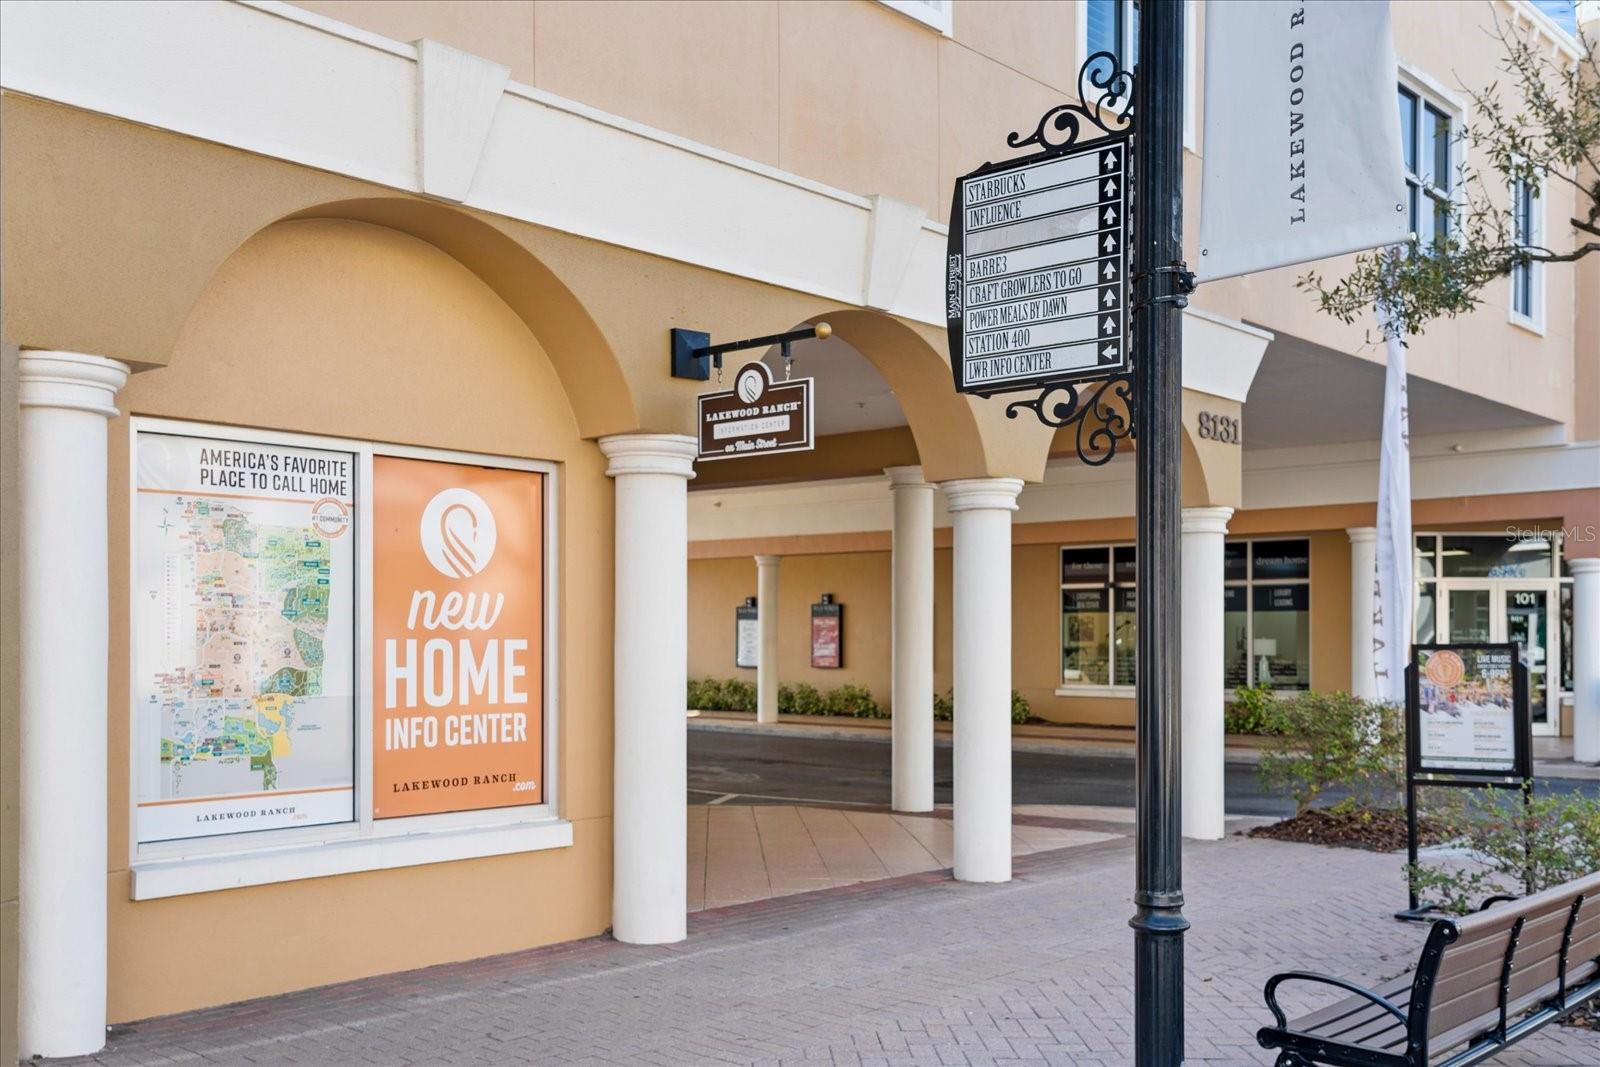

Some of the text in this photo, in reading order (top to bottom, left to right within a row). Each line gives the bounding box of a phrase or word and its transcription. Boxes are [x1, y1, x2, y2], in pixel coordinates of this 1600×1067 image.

[1290, 42, 1305, 225] LAKEWOOD
[968, 173, 1026, 203] STARBUCKS
[969, 200, 1022, 228] INFLUENCE
[969, 255, 1007, 279] BARRE3
[969, 267, 1082, 304] CRAFT GROWLERS TO GO
[969, 296, 1068, 330] POWER MEALS BY DAWN
[968, 328, 1030, 355] STATION 400
[969, 351, 1052, 380] LWR INFO CENTER
[706, 407, 760, 422] LAKEWOOD
[1199, 410, 1240, 445] 8131
[199, 448, 347, 478] AMERICA'S FAVORITE
[200, 468, 347, 496] PLACE TO CALL HOME
[407, 590, 505, 631] new
[1514, 593, 1536, 605] 101
[385, 638, 528, 709] HOME
[385, 712, 528, 751] INFO CENTER
[393, 772, 517, 793] LAKEWOOD RANCH
[512, 779, 537, 792] .com
[196, 807, 296, 823] LAKEWOOD RANCH
